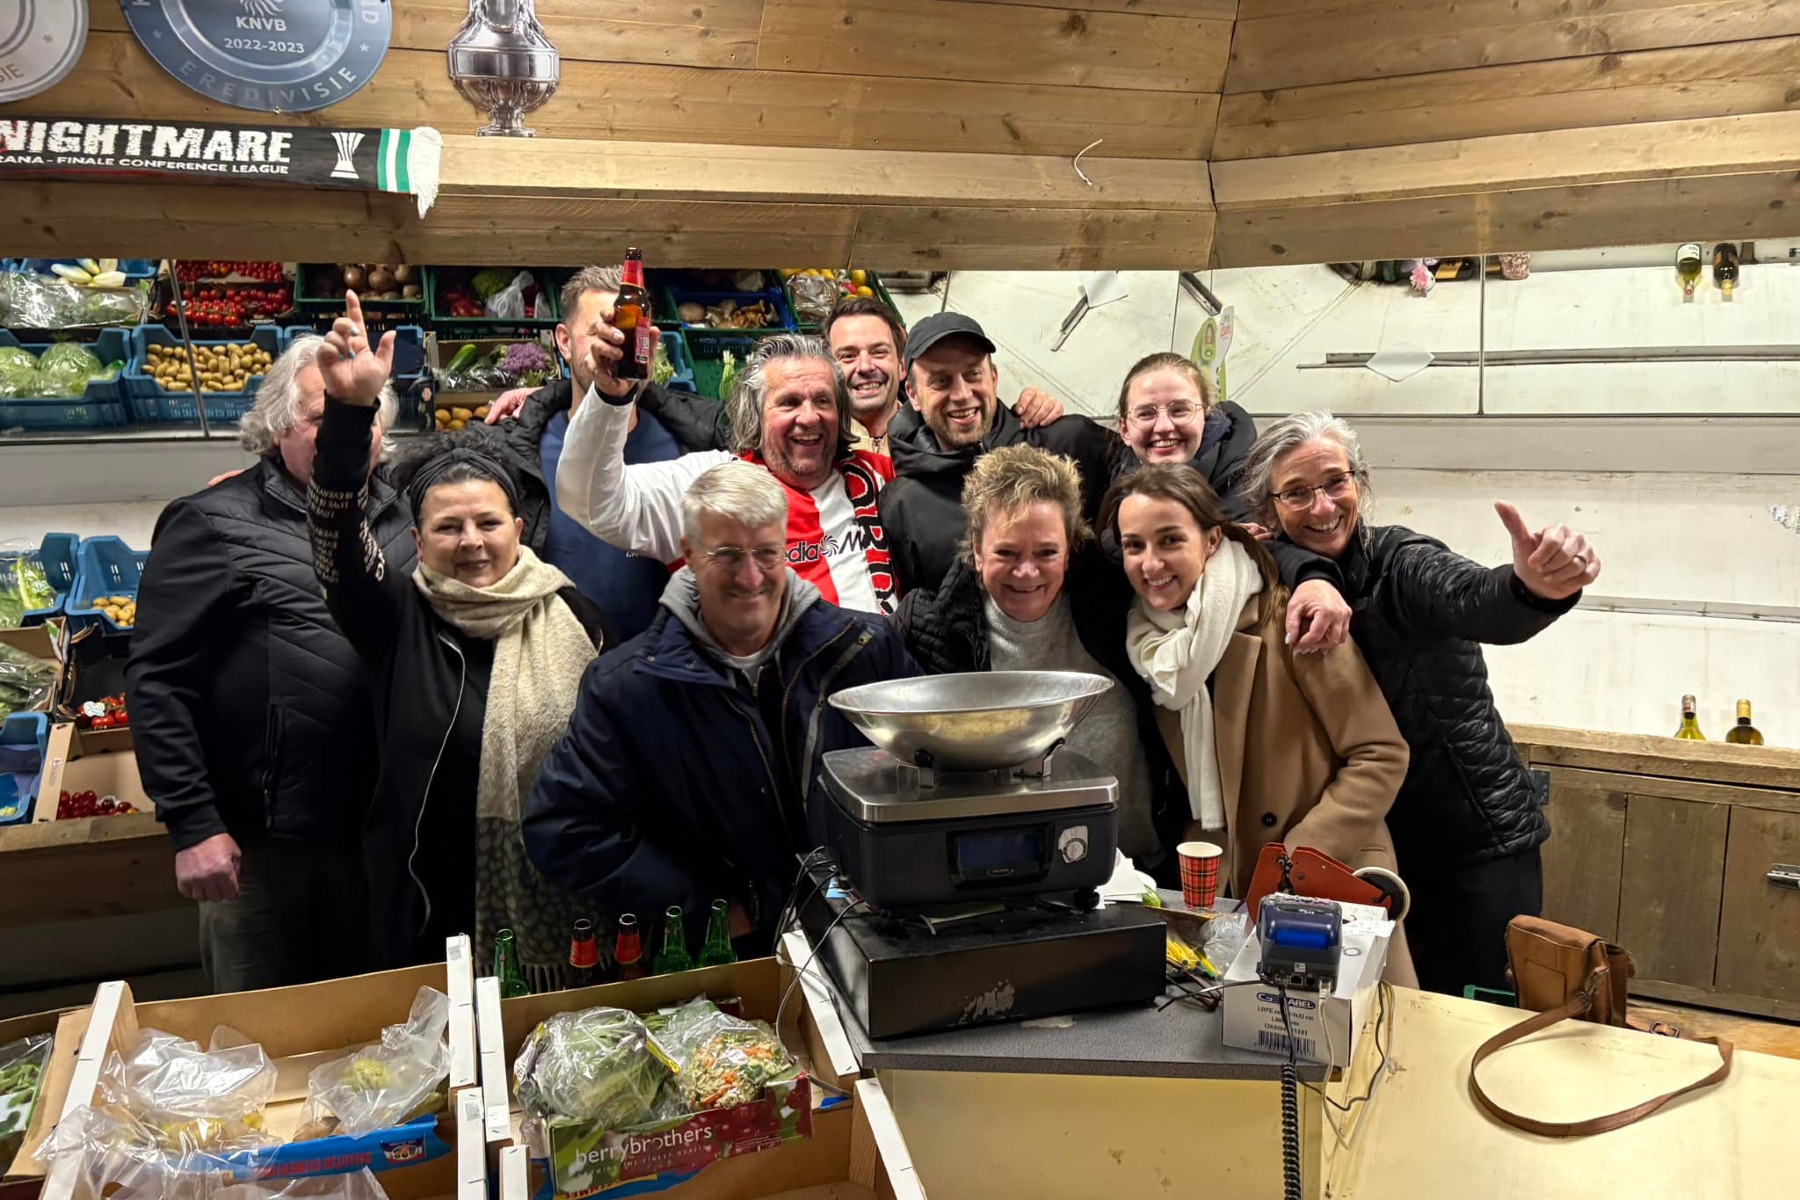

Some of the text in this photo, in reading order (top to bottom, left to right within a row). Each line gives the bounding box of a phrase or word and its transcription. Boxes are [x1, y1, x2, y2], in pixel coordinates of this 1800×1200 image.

[236, 16, 287, 32] KNVB
[224, 38, 305, 54] 2022-2023
[178, 60, 358, 104] EREDIVISIE
[0, 119, 293, 163] NIGHTMARE
[57, 155, 114, 166] FINALE
[118, 157, 228, 172] CONFERENCE
[232, 164, 289, 175] LEAGUE
[785, 541, 819, 564] dia
[576, 1124, 713, 1166] berrybrothers
